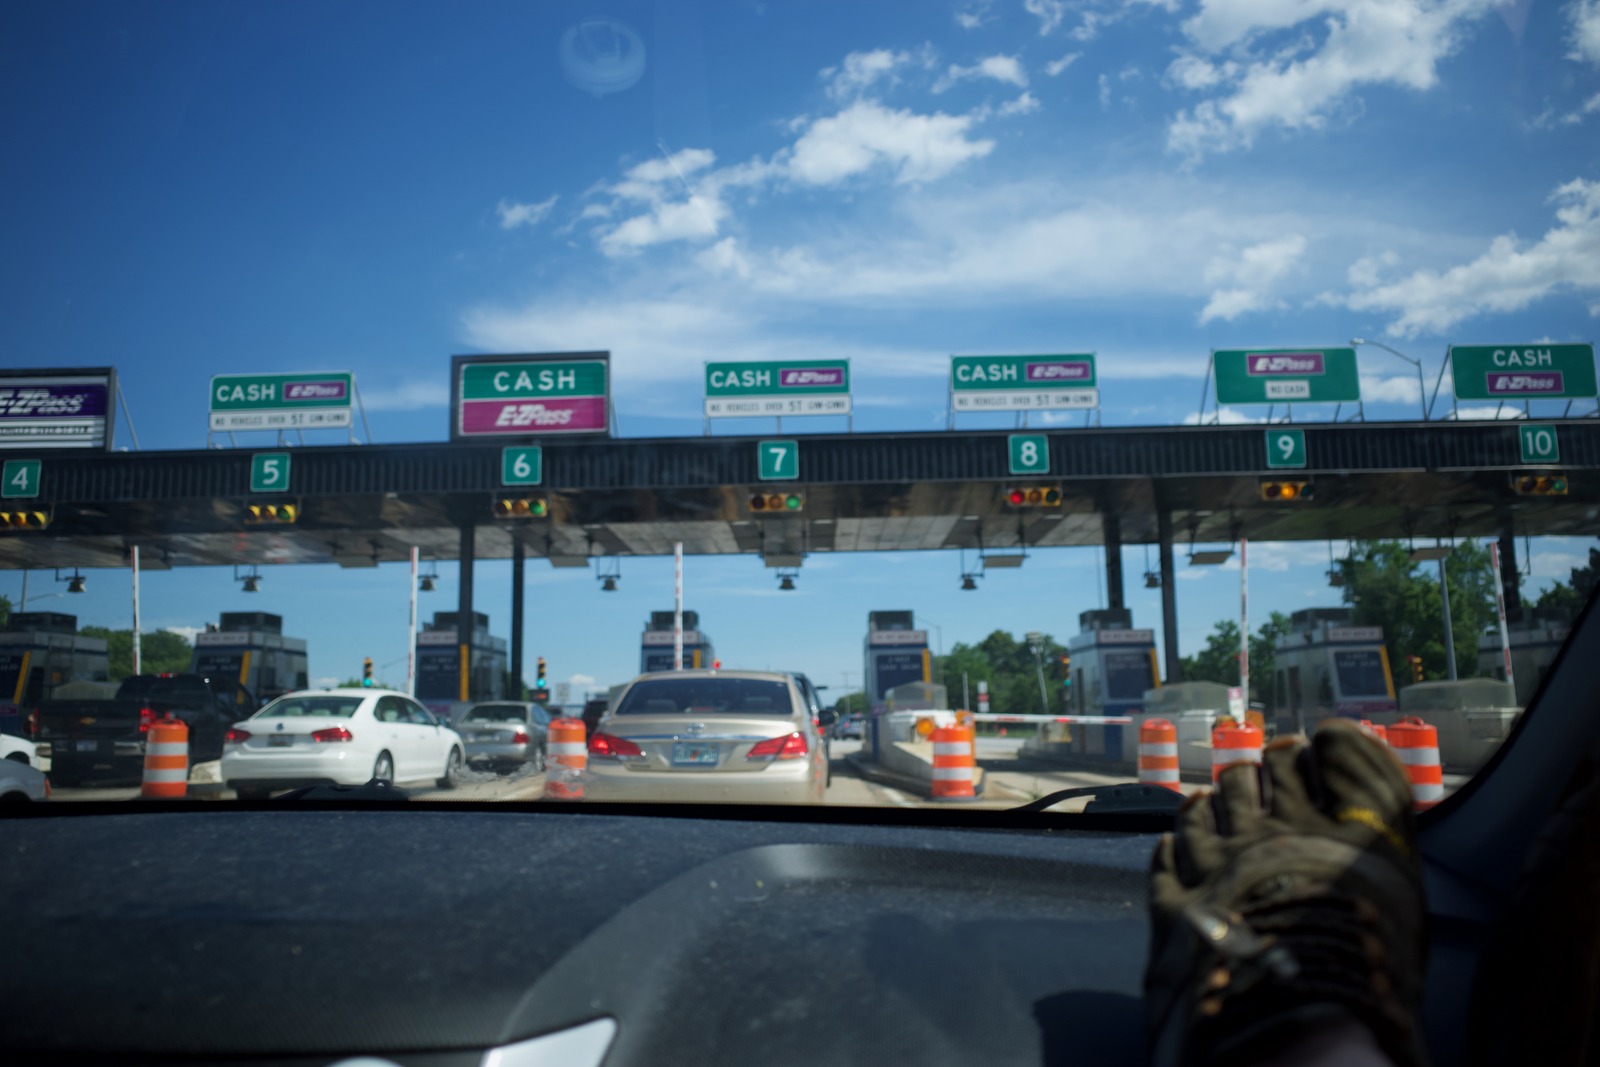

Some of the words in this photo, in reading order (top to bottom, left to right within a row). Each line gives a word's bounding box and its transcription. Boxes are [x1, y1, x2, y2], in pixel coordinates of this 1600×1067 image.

[1493, 349, 1552, 366] CASH
[493, 369, 575, 392] CASH
[710, 370, 771, 388] CASH
[956, 364, 1017, 381] CASH
[216, 383, 275, 402] CASH
[1020, 441, 1038, 467] 8
[1277, 435, 1294, 460] 9
[1526, 430, 1552, 455] 10
[513, 453, 531, 478] 6
[769, 447, 787, 472] 7
[11, 466, 28, 490] 4
[262, 459, 279, 485] 5
